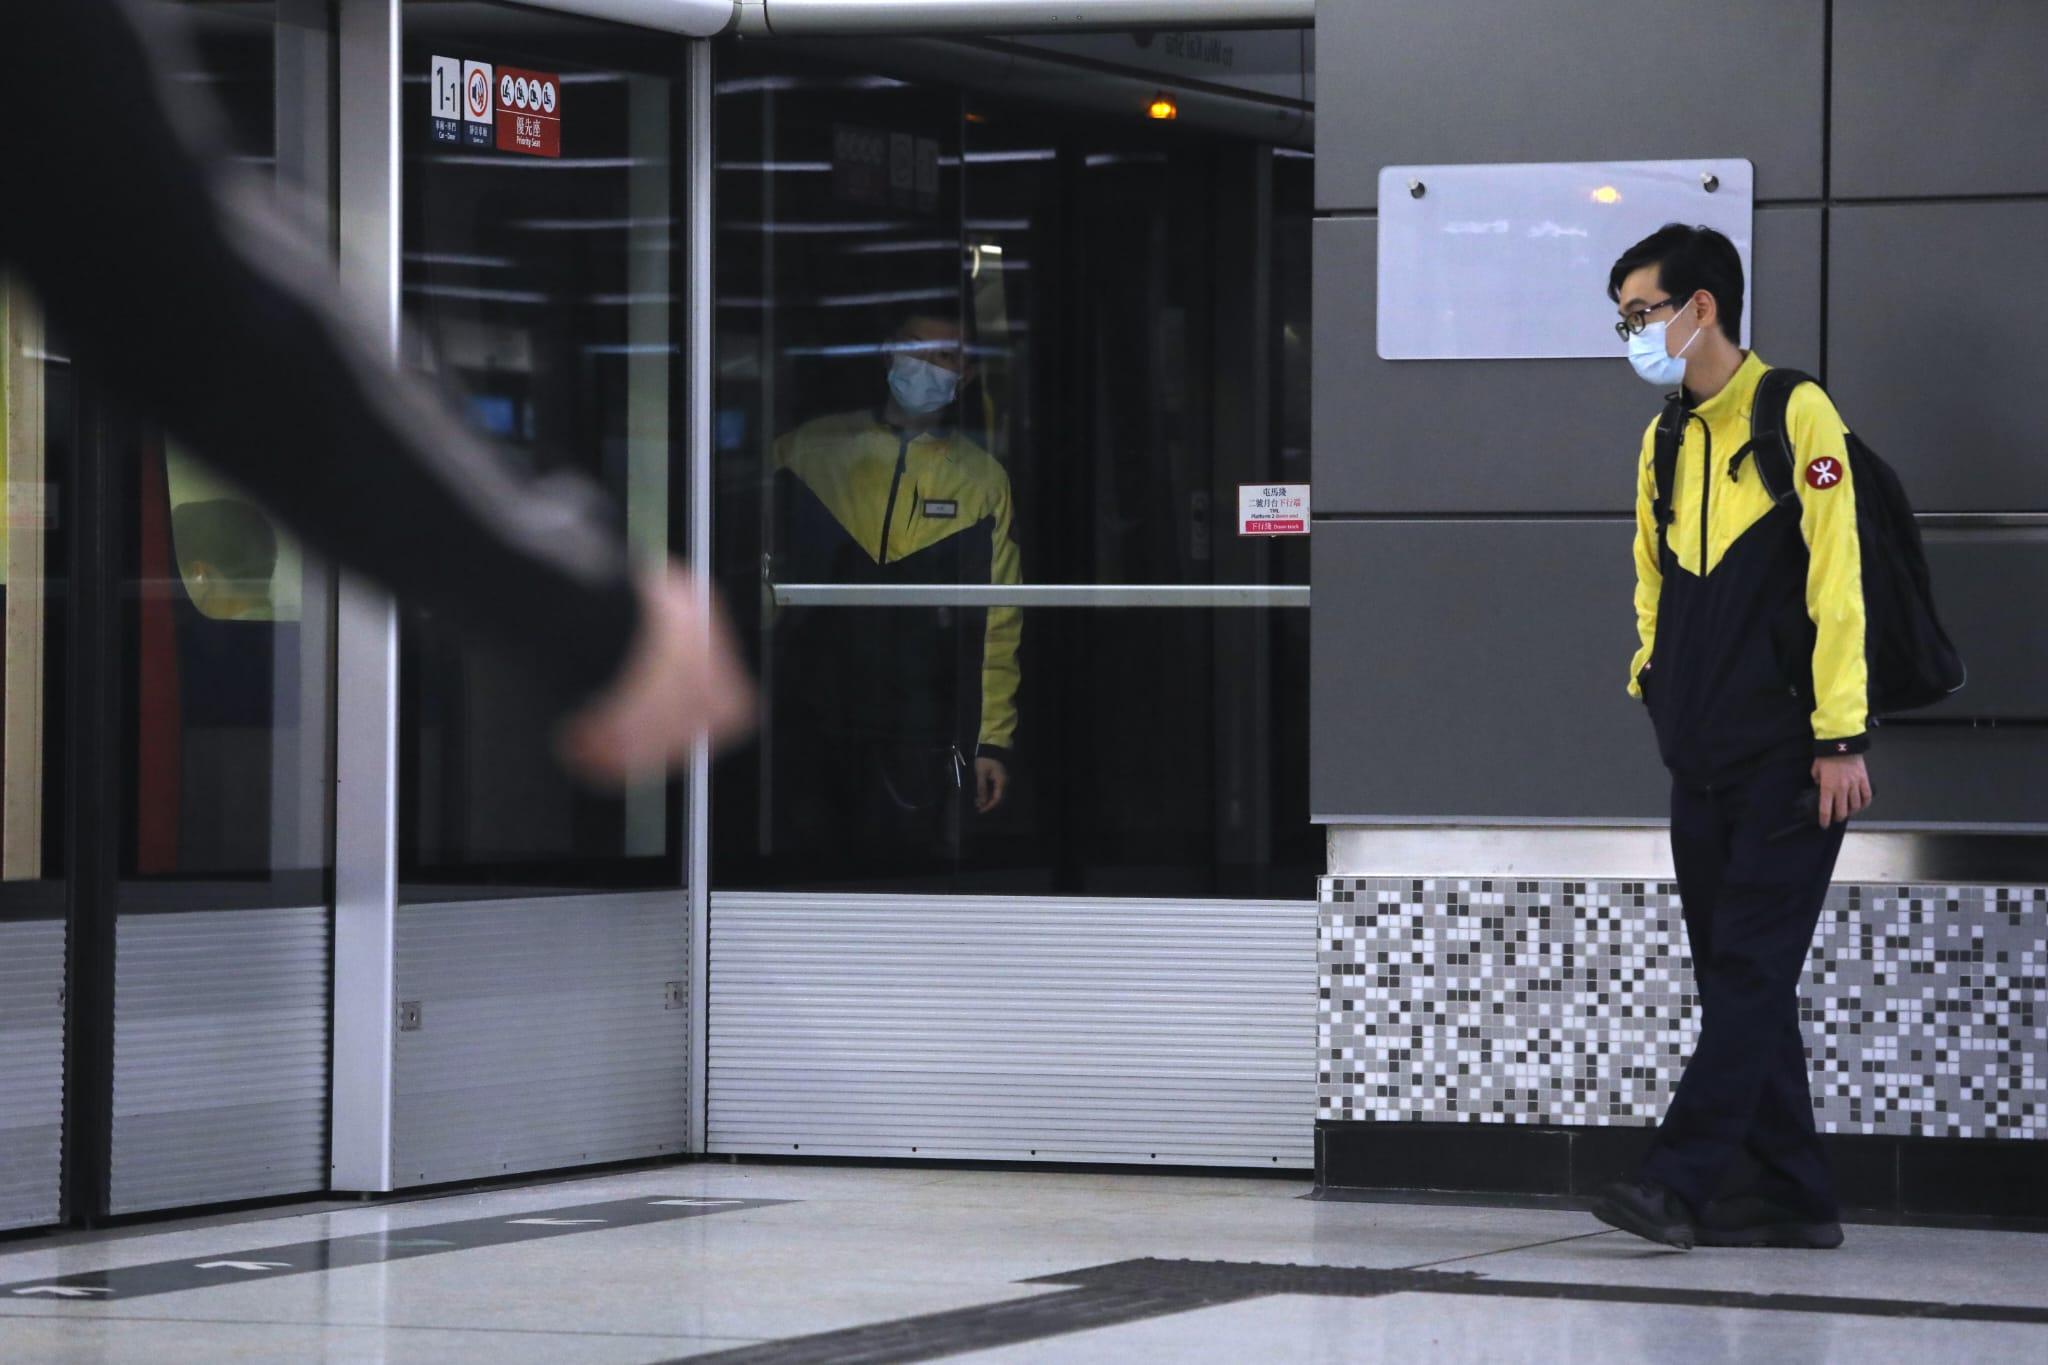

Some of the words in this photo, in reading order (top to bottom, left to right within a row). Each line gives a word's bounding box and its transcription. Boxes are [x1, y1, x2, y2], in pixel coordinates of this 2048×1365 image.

[437, 66, 455, 112] 1-1
[516, 116, 541, 138] 優先座
[516, 135, 531, 148] Priority
[531, 138, 541, 148] Seat
